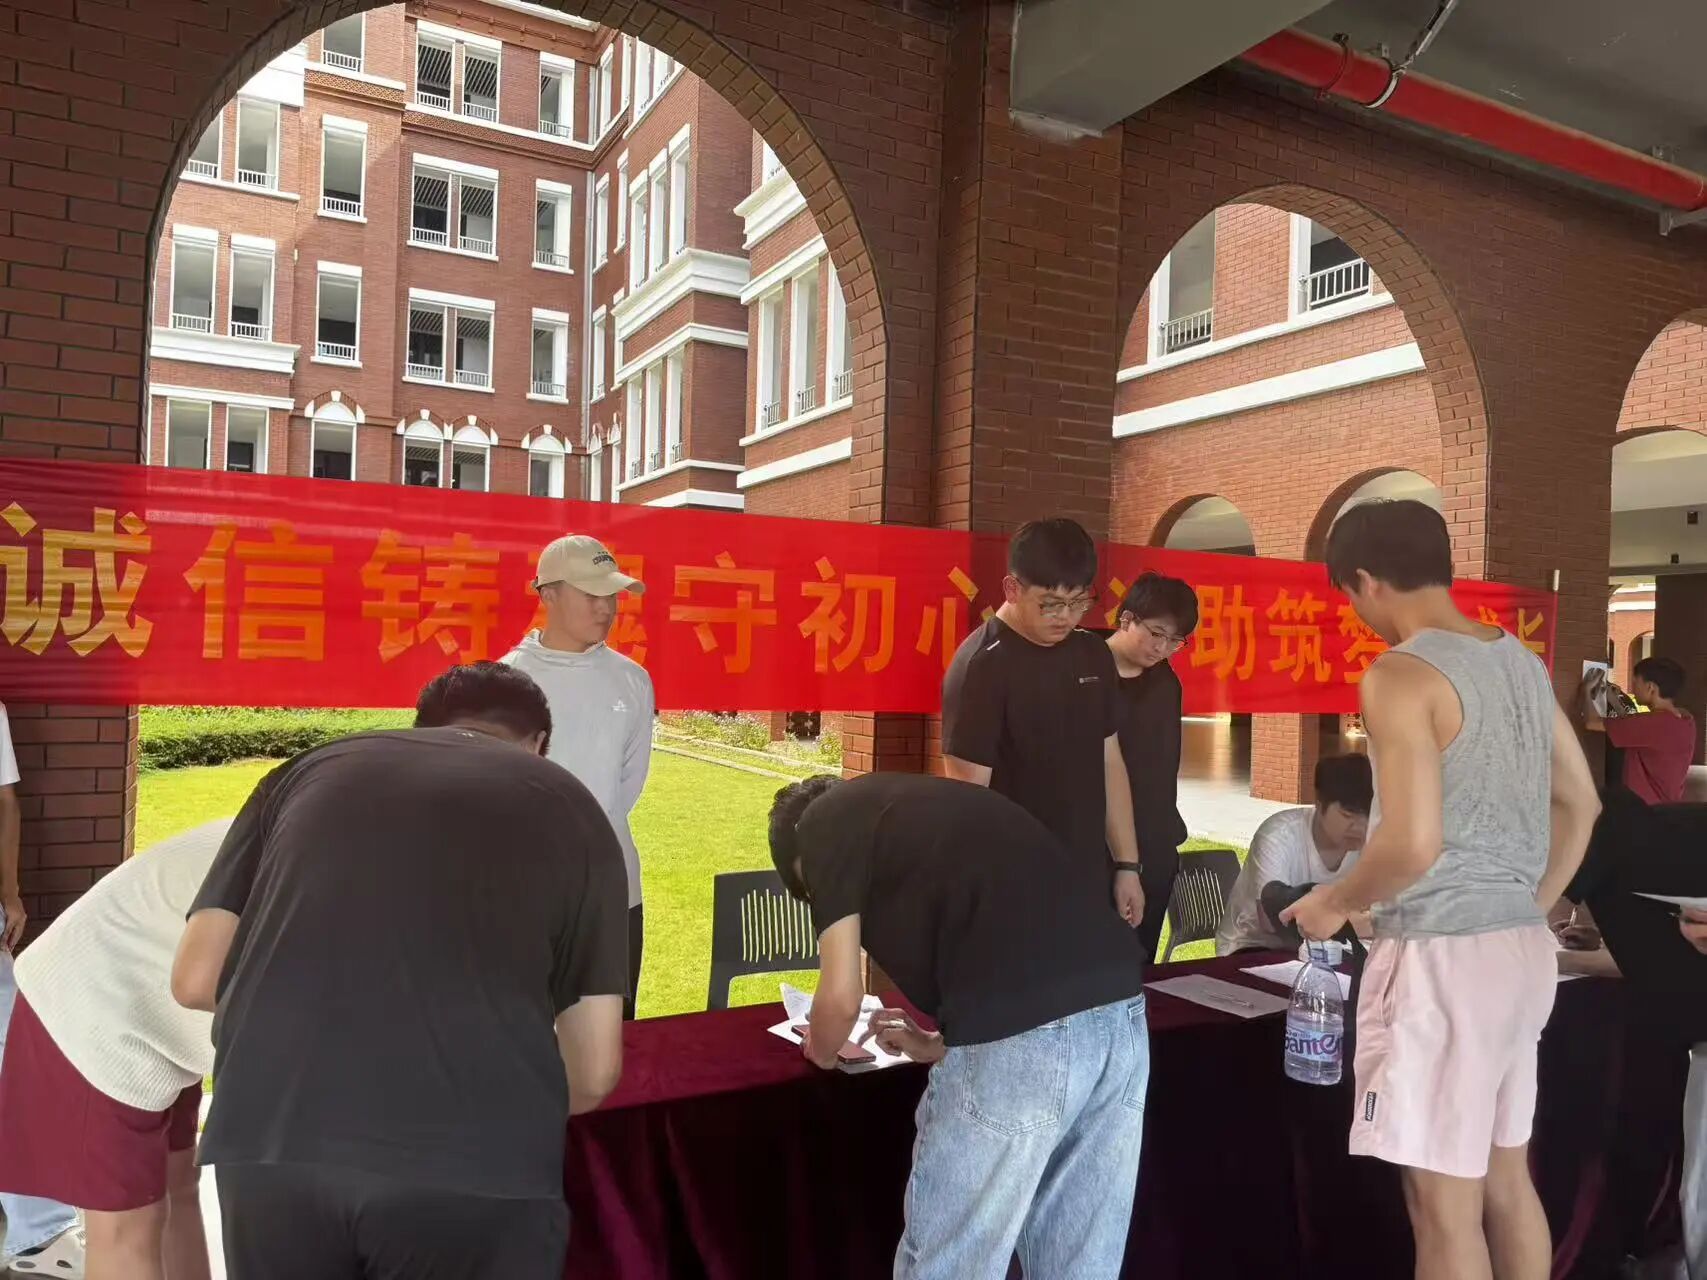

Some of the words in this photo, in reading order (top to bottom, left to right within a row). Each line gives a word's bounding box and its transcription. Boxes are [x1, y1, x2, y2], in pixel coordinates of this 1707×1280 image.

[0, 502, 996, 676] 诚信铸守初心
